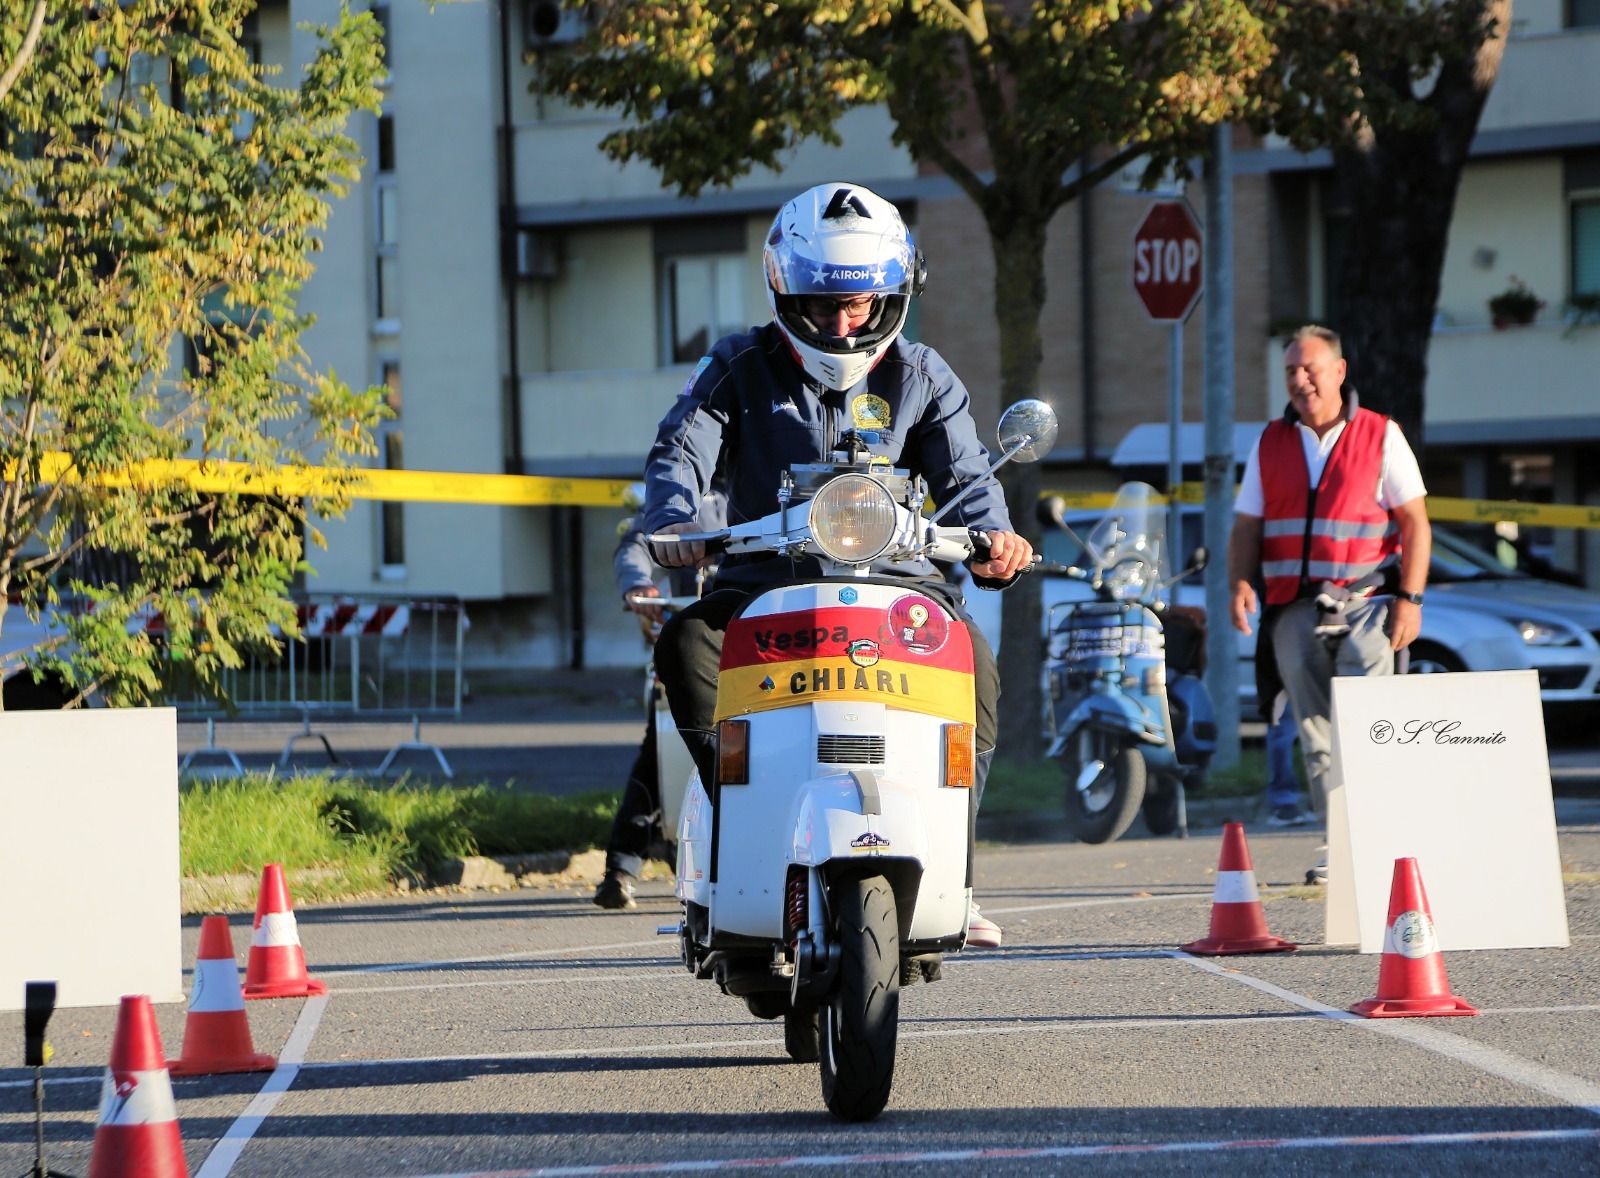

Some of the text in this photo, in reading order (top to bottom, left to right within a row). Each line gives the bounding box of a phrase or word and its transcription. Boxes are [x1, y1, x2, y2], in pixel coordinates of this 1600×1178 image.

[831, 270, 870, 280] AIROH
[1136, 238, 1200, 284] STOP
[909, 604, 929, 628] 9
[755, 625, 848, 653] Vespa
[790, 667, 909, 695] CHIARI
